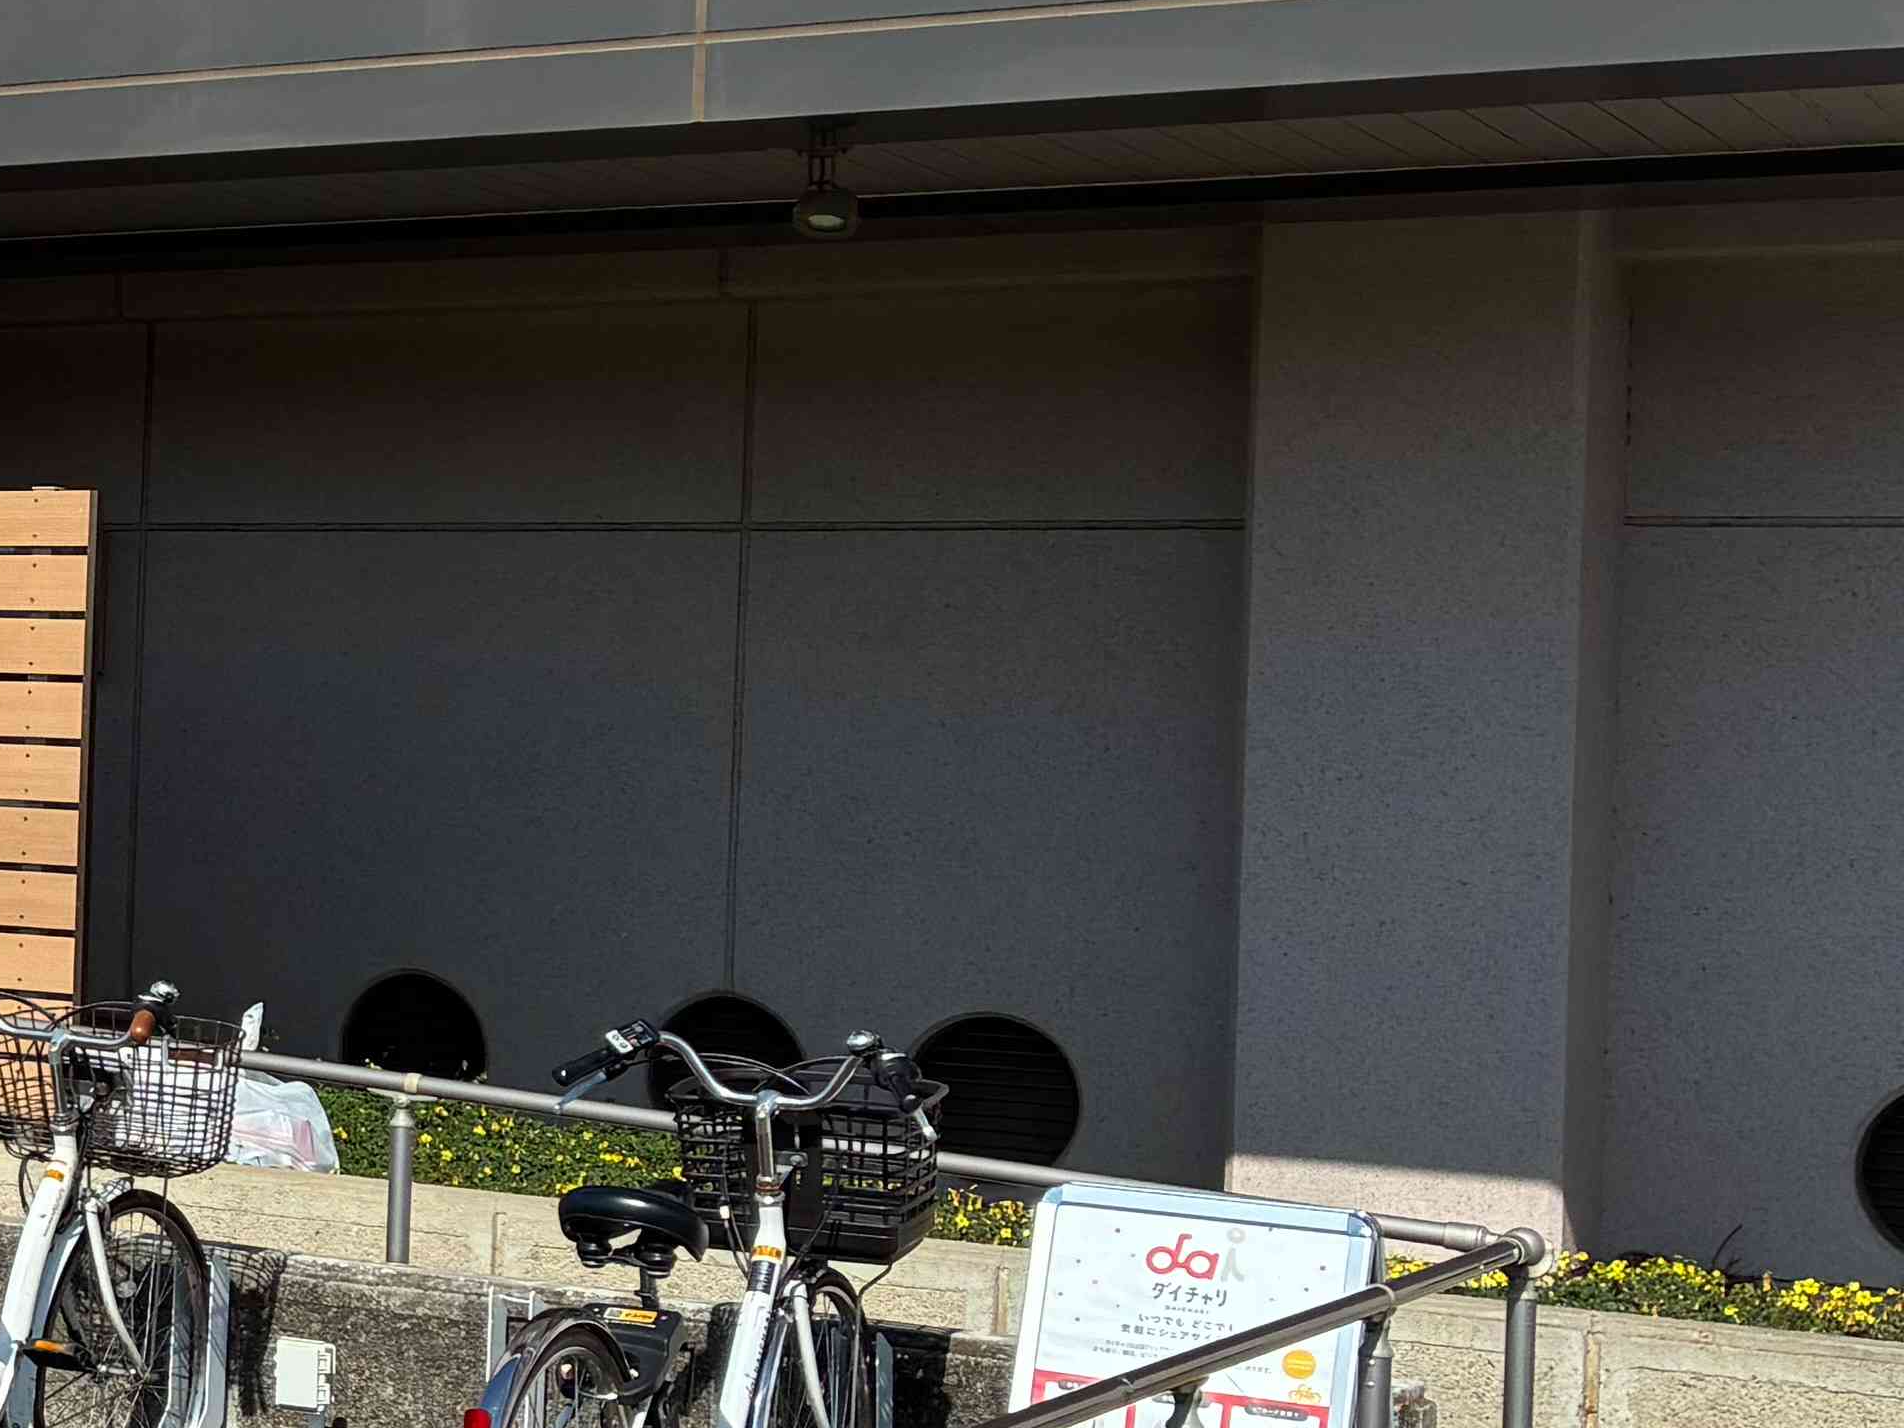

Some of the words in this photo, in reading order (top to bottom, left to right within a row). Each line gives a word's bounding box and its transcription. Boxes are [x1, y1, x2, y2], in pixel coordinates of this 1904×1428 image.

[1151, 1281, 1228, 1307] ダイチャリ
[1138, 1313, 1185, 1328] いつでも
